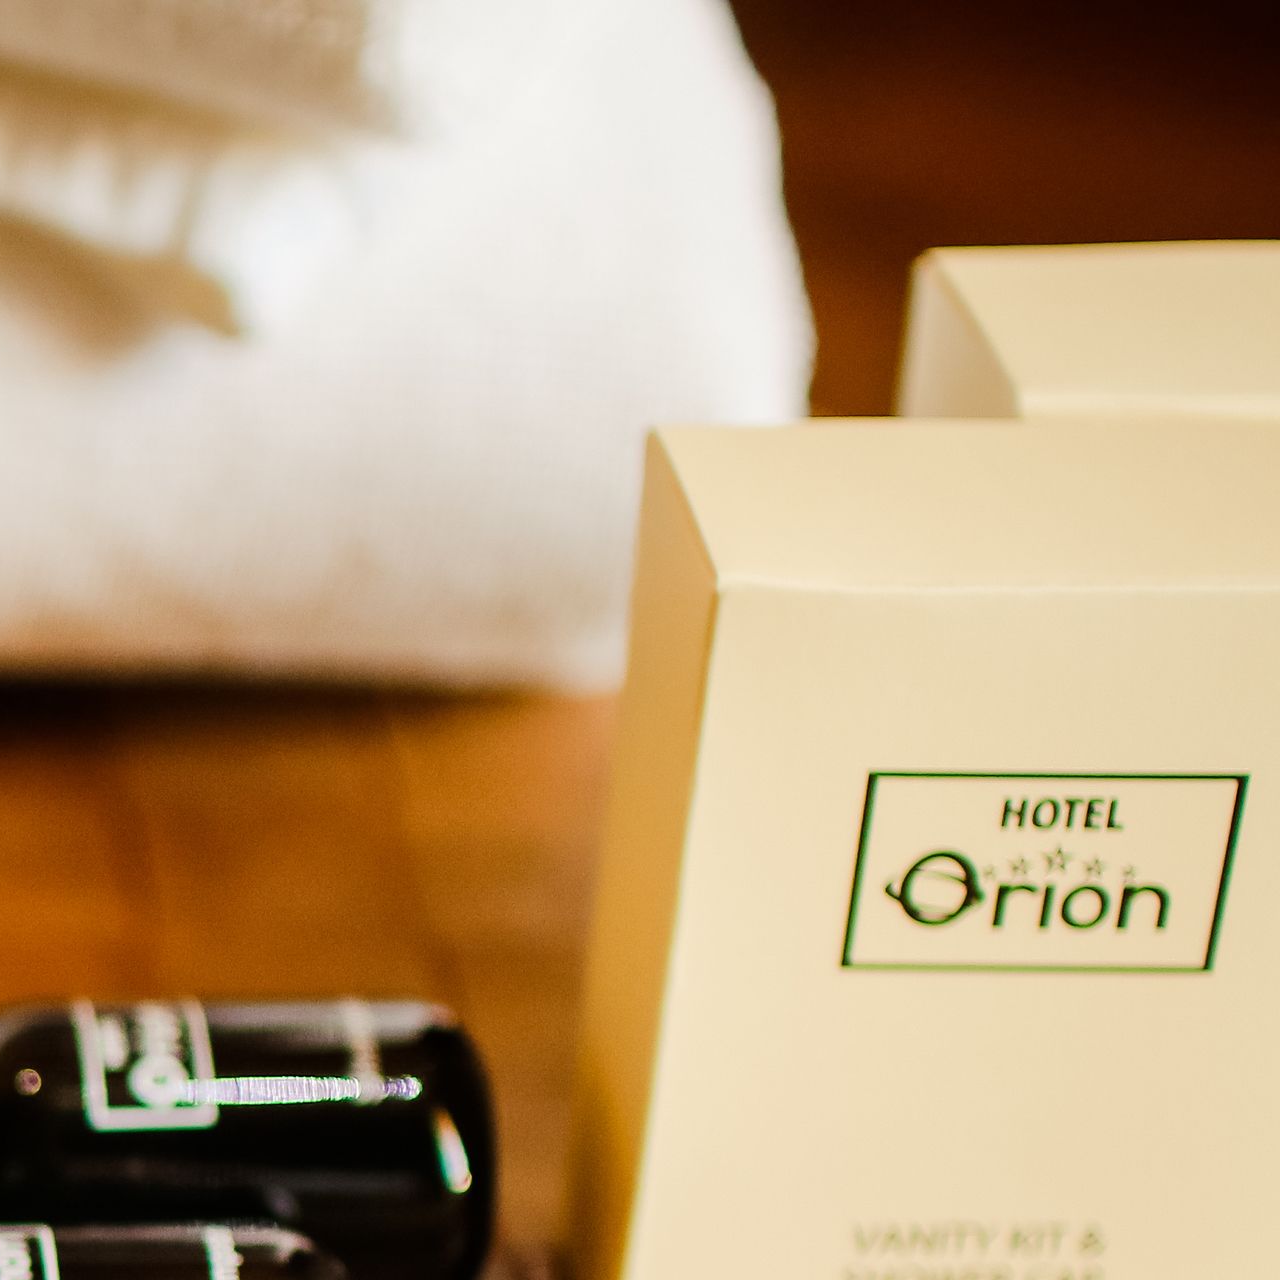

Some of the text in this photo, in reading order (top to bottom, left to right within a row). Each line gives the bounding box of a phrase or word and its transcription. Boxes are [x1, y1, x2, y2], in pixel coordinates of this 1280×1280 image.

[1000, 798, 1124, 830] HOTEL
[885, 849, 1171, 930] Orion
[851, 1221, 1000, 1256] VANITY
[1007, 1221, 1070, 1256] KIT
